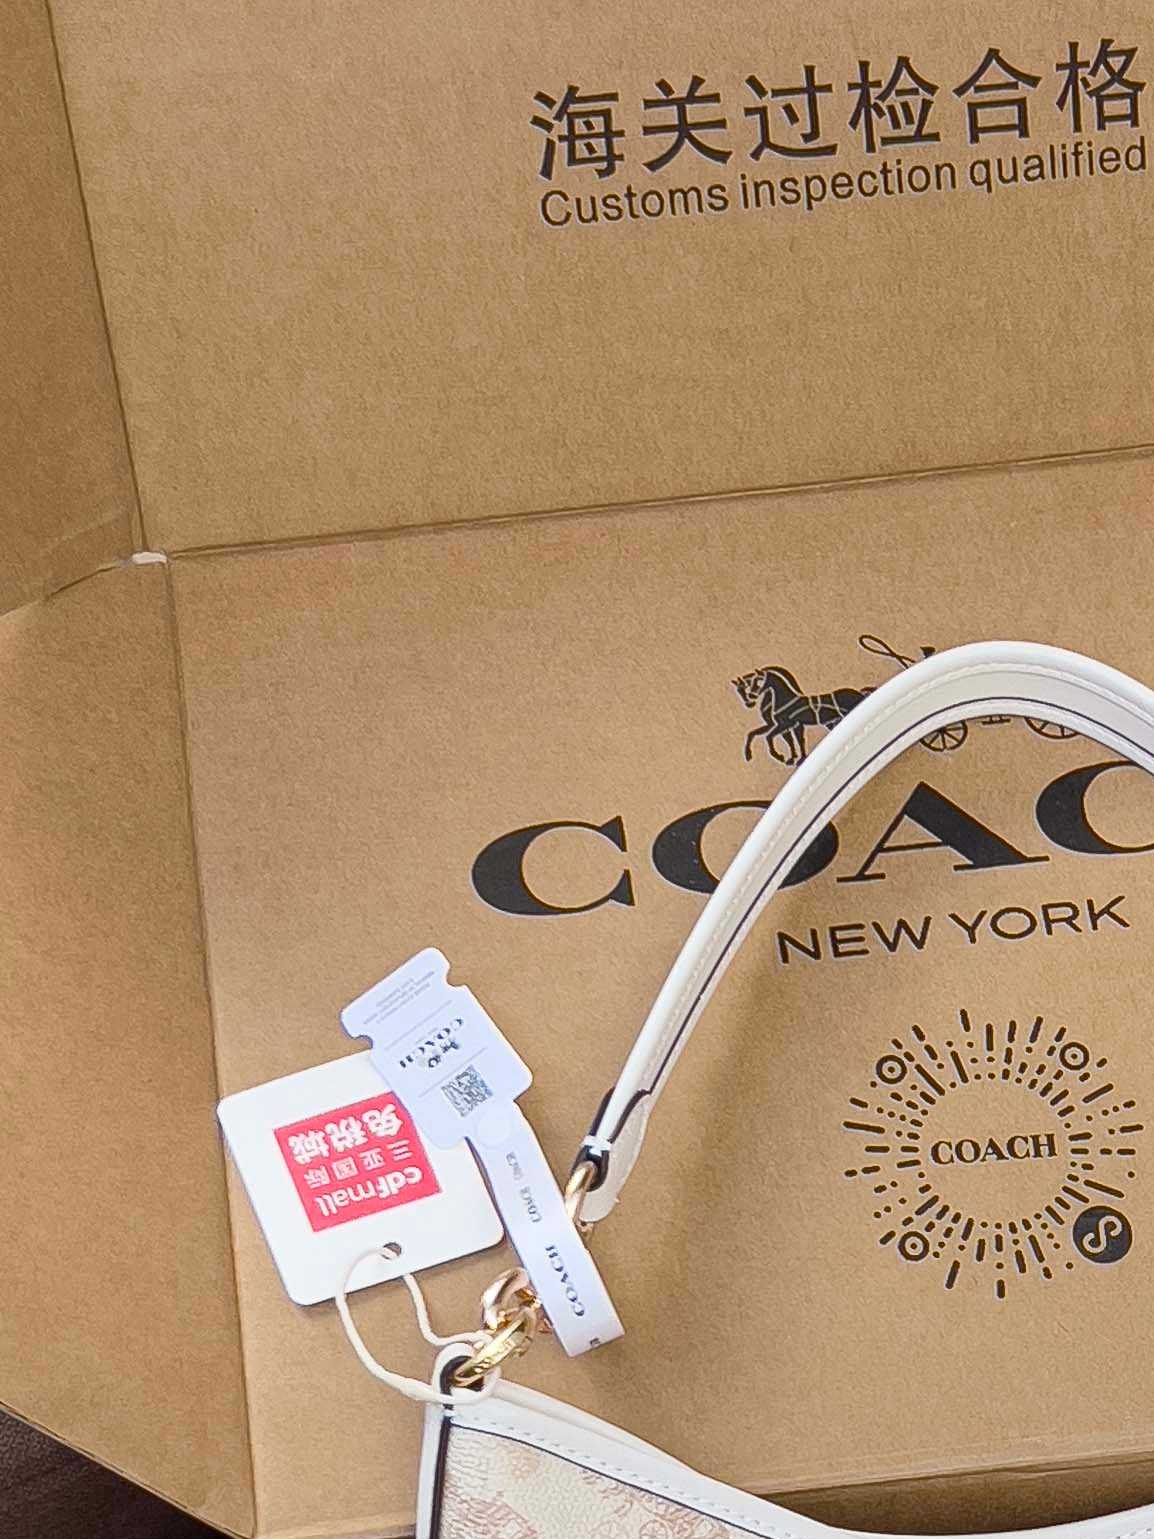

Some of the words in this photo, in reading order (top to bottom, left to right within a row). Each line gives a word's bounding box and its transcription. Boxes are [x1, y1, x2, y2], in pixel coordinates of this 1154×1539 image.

[530, 37, 1148, 181] 海关过检合格
[540, 181, 729, 228] Customs
[740, 158, 957, 210] inspection
[969, 136, 1147, 188] qualified
[776, 914, 932, 966] NEW
[948, 894, 1132, 946] YORK
[287, 1102, 404, 1166] 免税城
[302, 1138, 414, 1191] 三亚国际
[930, 1132, 1058, 1165] COACH
